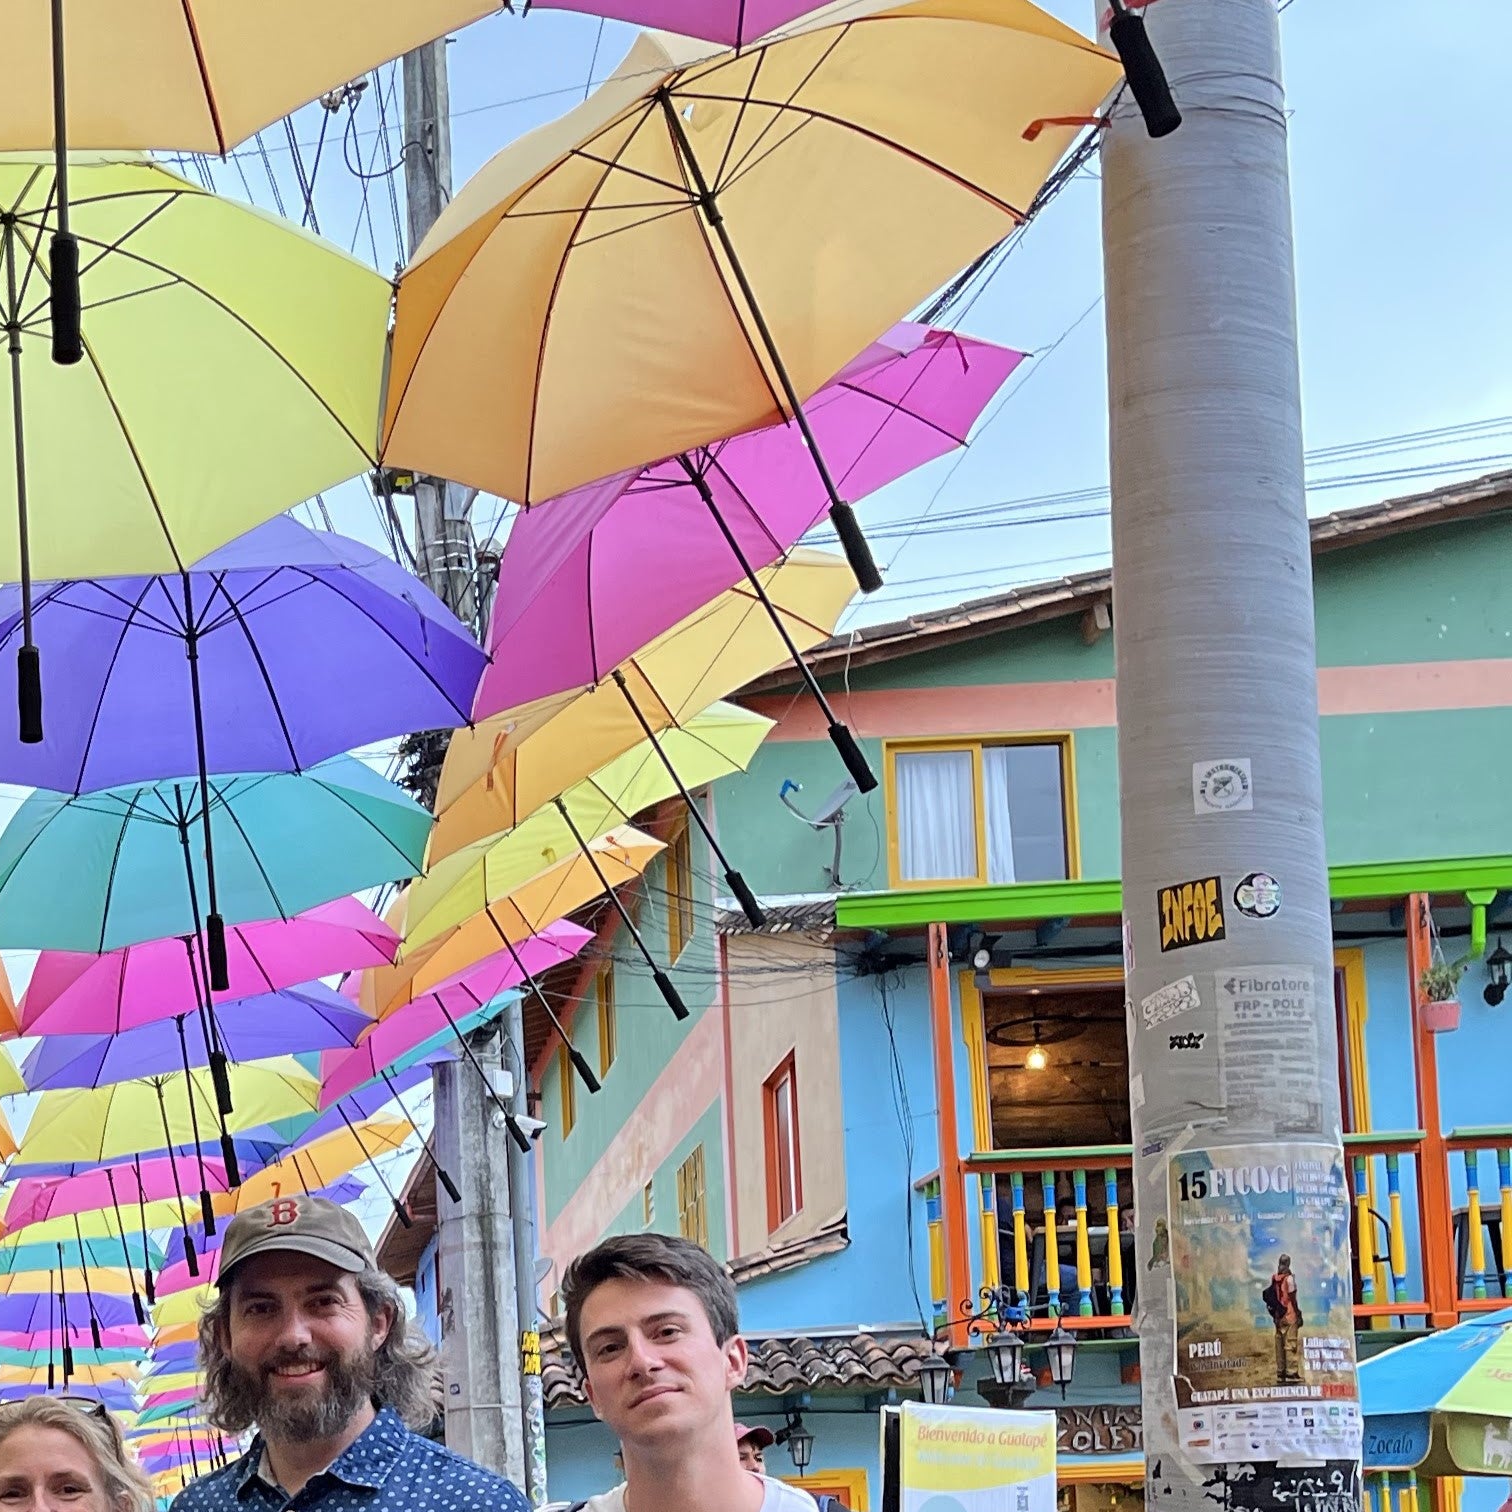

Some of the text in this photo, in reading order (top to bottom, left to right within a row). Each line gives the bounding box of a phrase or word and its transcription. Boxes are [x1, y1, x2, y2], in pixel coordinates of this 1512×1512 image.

[1178, 1164, 1290, 1201] 15 FICOG
[266, 1199, 300, 1228] B
[1188, 1338, 1222, 1359] PERÚ
[918, 1425, 1047, 1451] Bienvenido a Guatapé
[1369, 1434, 1413, 1455] Zocalo
